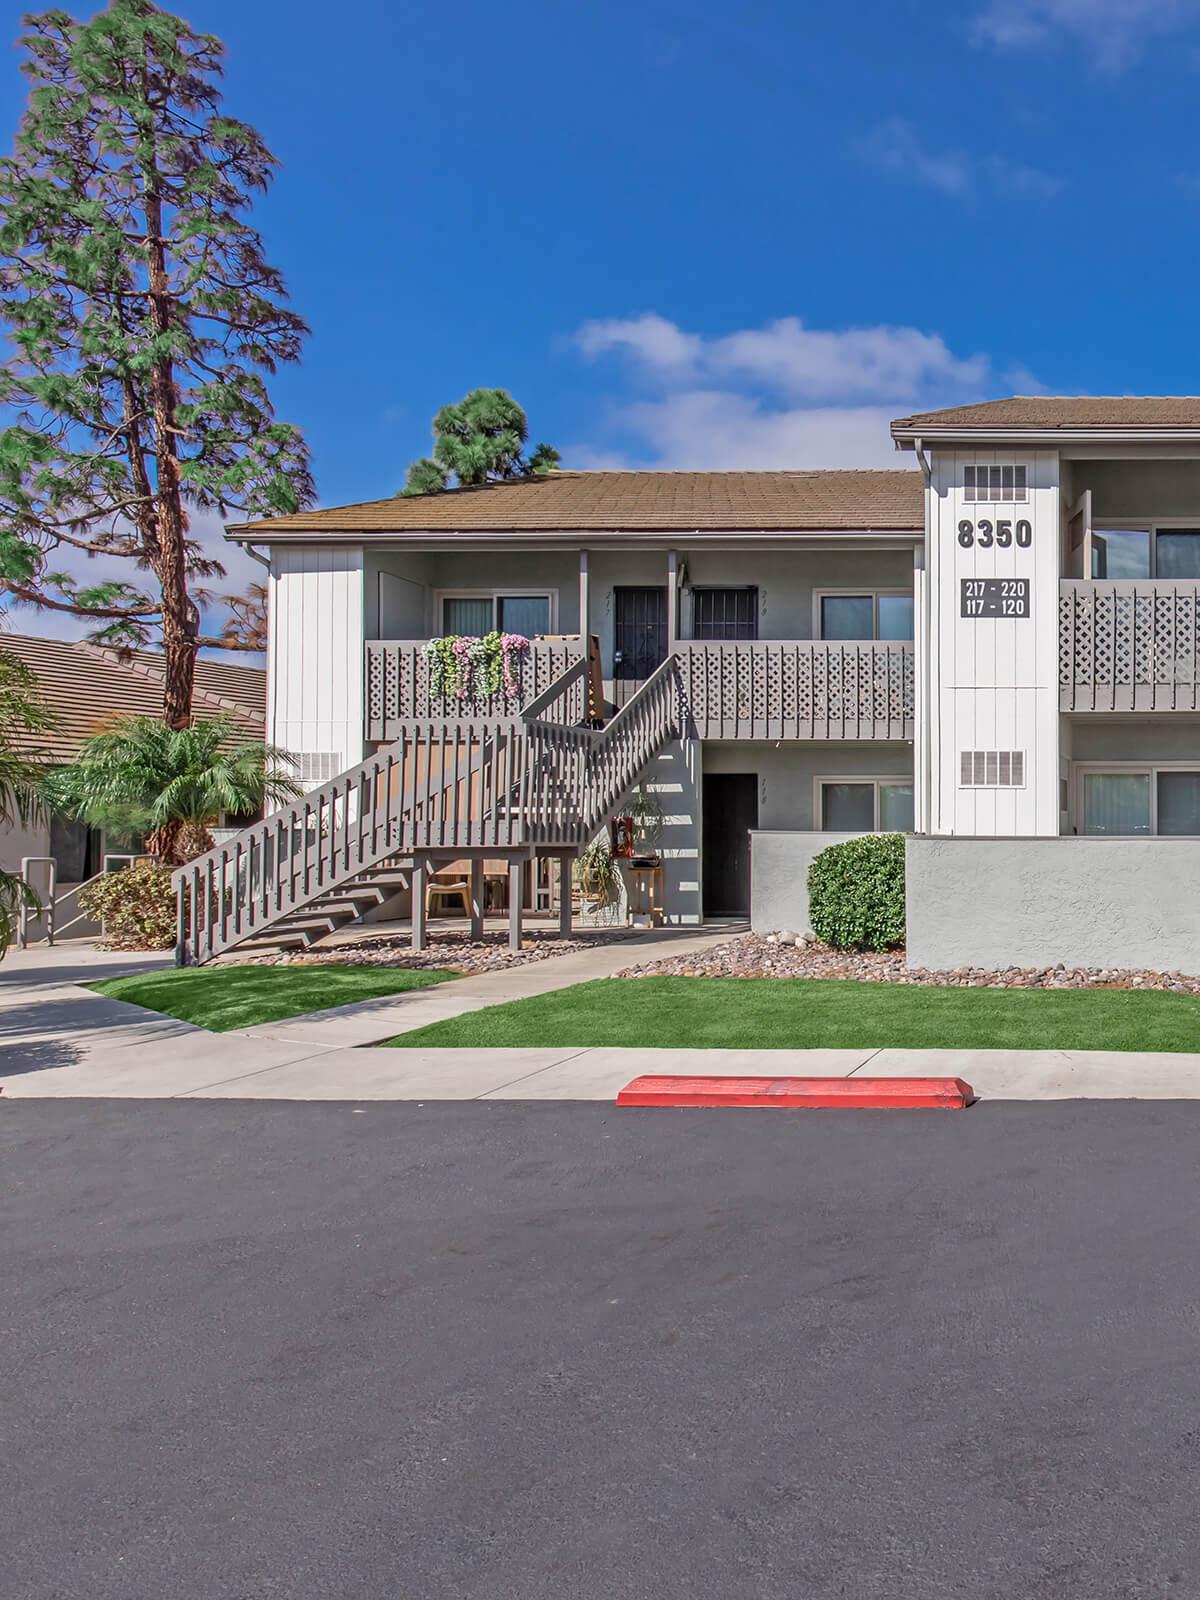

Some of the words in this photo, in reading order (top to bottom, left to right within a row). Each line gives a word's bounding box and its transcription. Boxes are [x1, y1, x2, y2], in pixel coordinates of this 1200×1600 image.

[958, 519, 1032, 549] 8350
[966, 582, 985, 597] 217
[1001, 582, 1025, 597] 220
[966, 600, 985, 615] 117
[1002, 600, 1025, 615] 120
